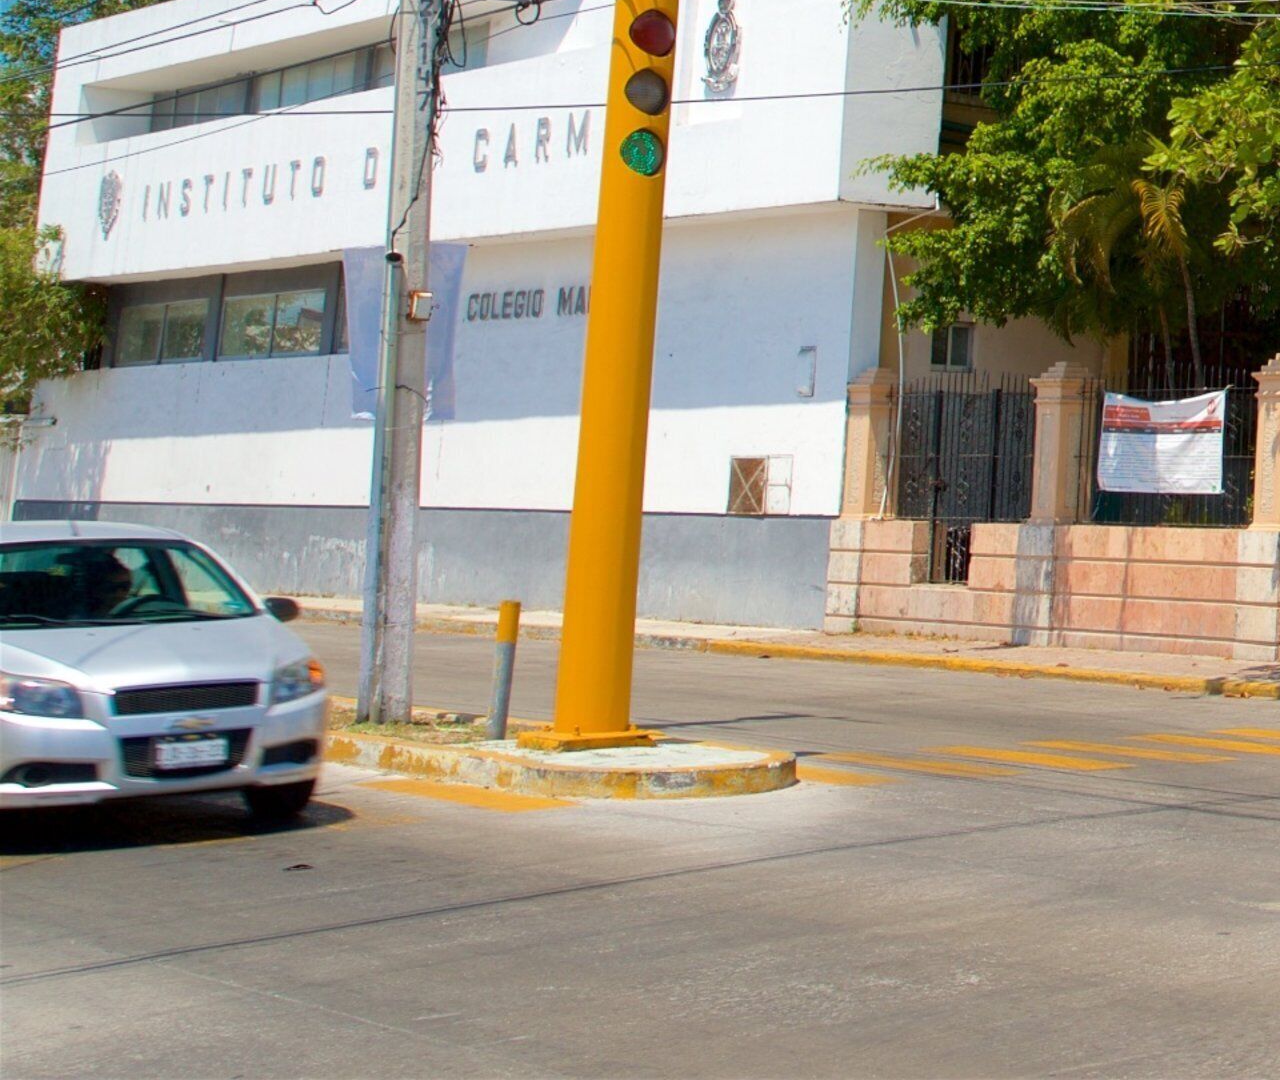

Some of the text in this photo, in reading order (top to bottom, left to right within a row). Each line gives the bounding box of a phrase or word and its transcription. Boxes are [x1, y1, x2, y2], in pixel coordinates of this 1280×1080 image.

[473, 109, 592, 173] CARM
[142, 156, 326, 223] INSTITUTO
[467, 285, 592, 322] COLEGIO MA
